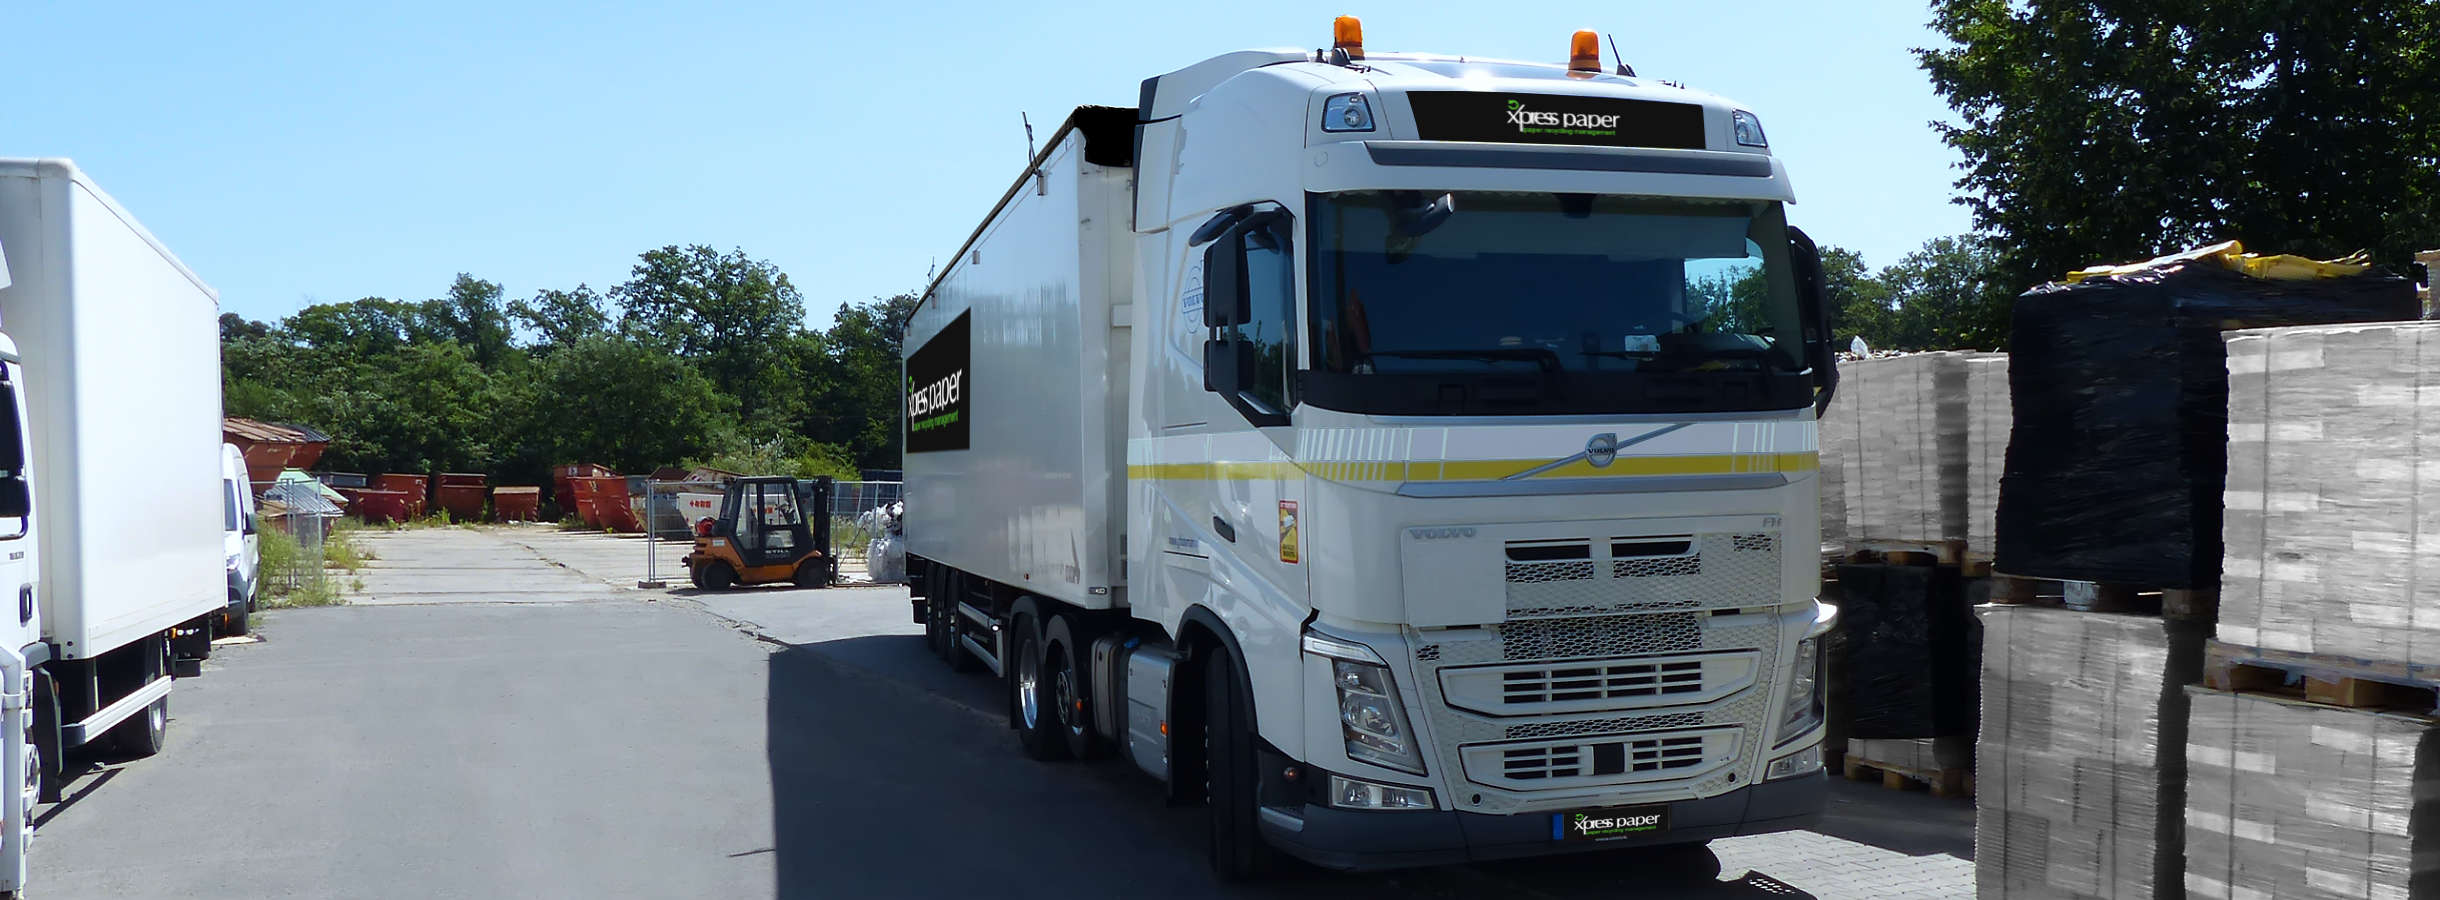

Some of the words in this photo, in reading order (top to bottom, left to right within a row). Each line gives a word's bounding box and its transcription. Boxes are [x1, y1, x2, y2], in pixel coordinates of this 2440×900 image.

[1562, 113, 1621, 128] paper
[1574, 129, 1616, 137] management
[929, 368, 962, 415] paper
[1409, 528, 1476, 539] VOLVO
[1616, 814, 1661, 828] paper
